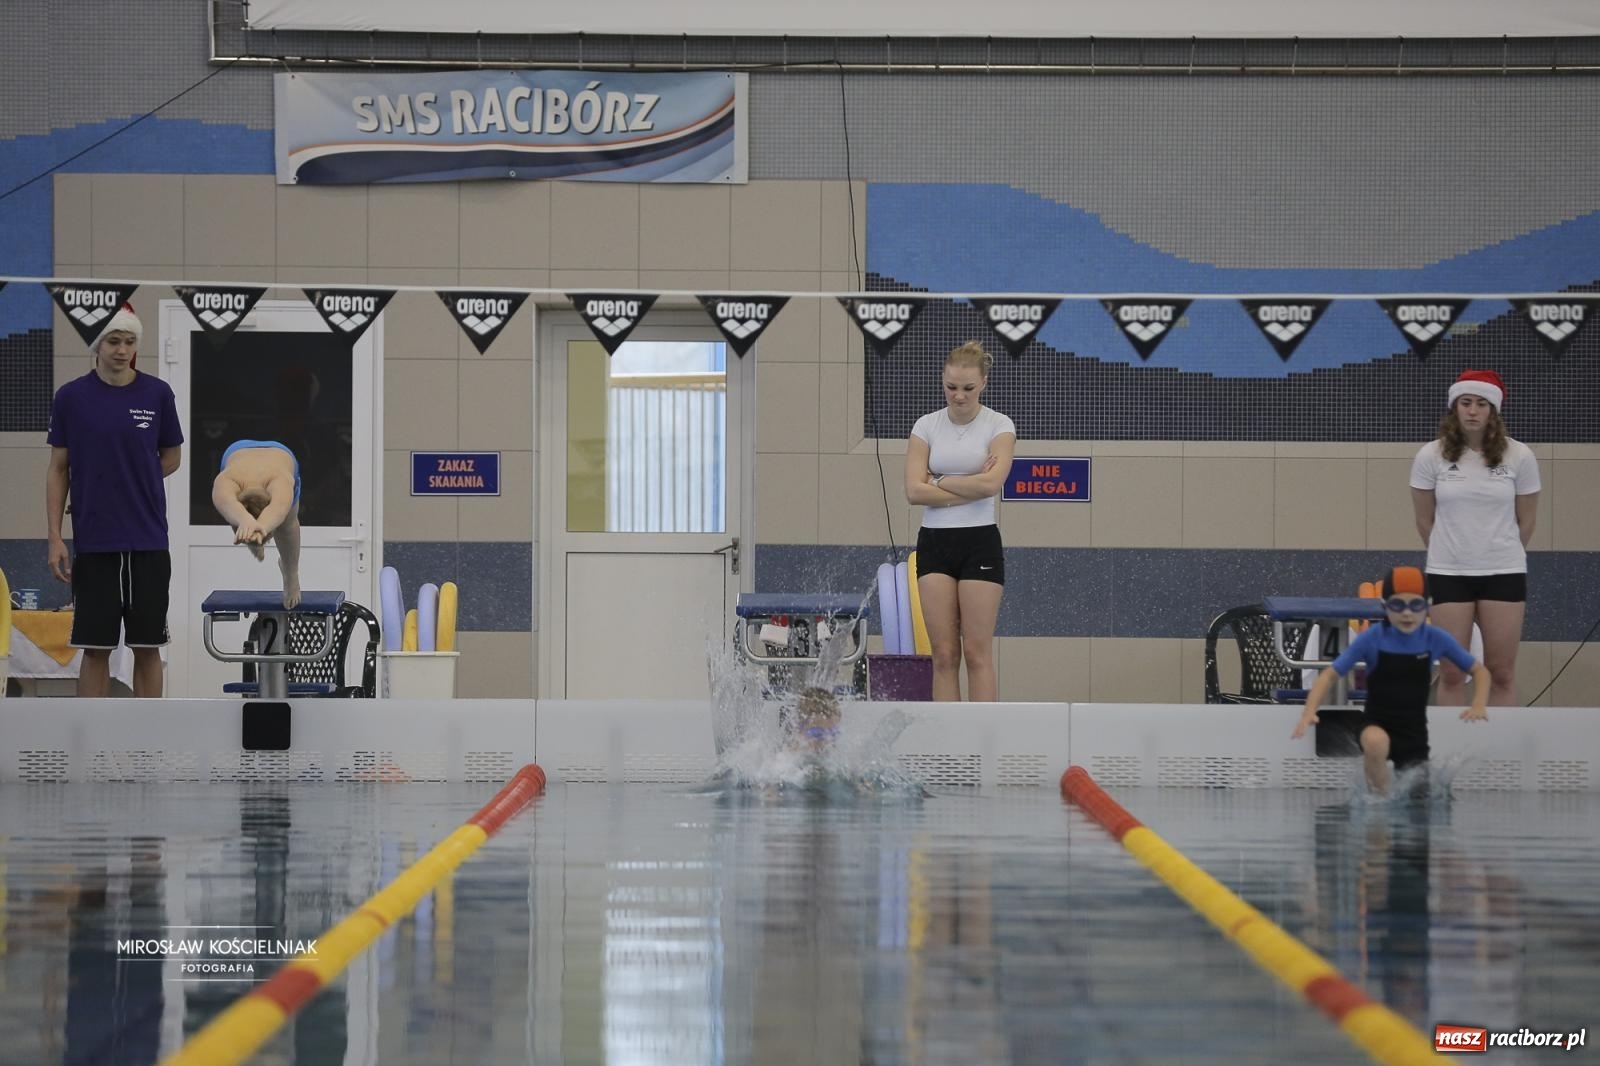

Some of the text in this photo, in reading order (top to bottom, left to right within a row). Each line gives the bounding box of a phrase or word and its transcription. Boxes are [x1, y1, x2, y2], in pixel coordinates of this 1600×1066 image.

[352, 80, 661, 135] SMS RACIBÓRZ
[63, 288, 117, 306] arena
[193, 292, 247, 310] arena
[322, 294, 376, 312] arena
[456, 297, 509, 315] arena
[586, 300, 639, 317] arena
[716, 301, 769, 319] arena
[857, 303, 910, 320] arena
[989, 303, 1042, 321] arena
[1119, 304, 1173, 321] arena
[1258, 304, 1312, 321] arena
[1397, 304, 1451, 321] arena
[1529, 304, 1583, 321] arena
[438, 459, 474, 472] ZAKAZ
[1031, 465, 1060, 477] NIE
[429, 475, 484, 488] SKAKANIA
[1015, 481, 1077, 494] BIEGAJ
[261, 617, 280, 656] 2
